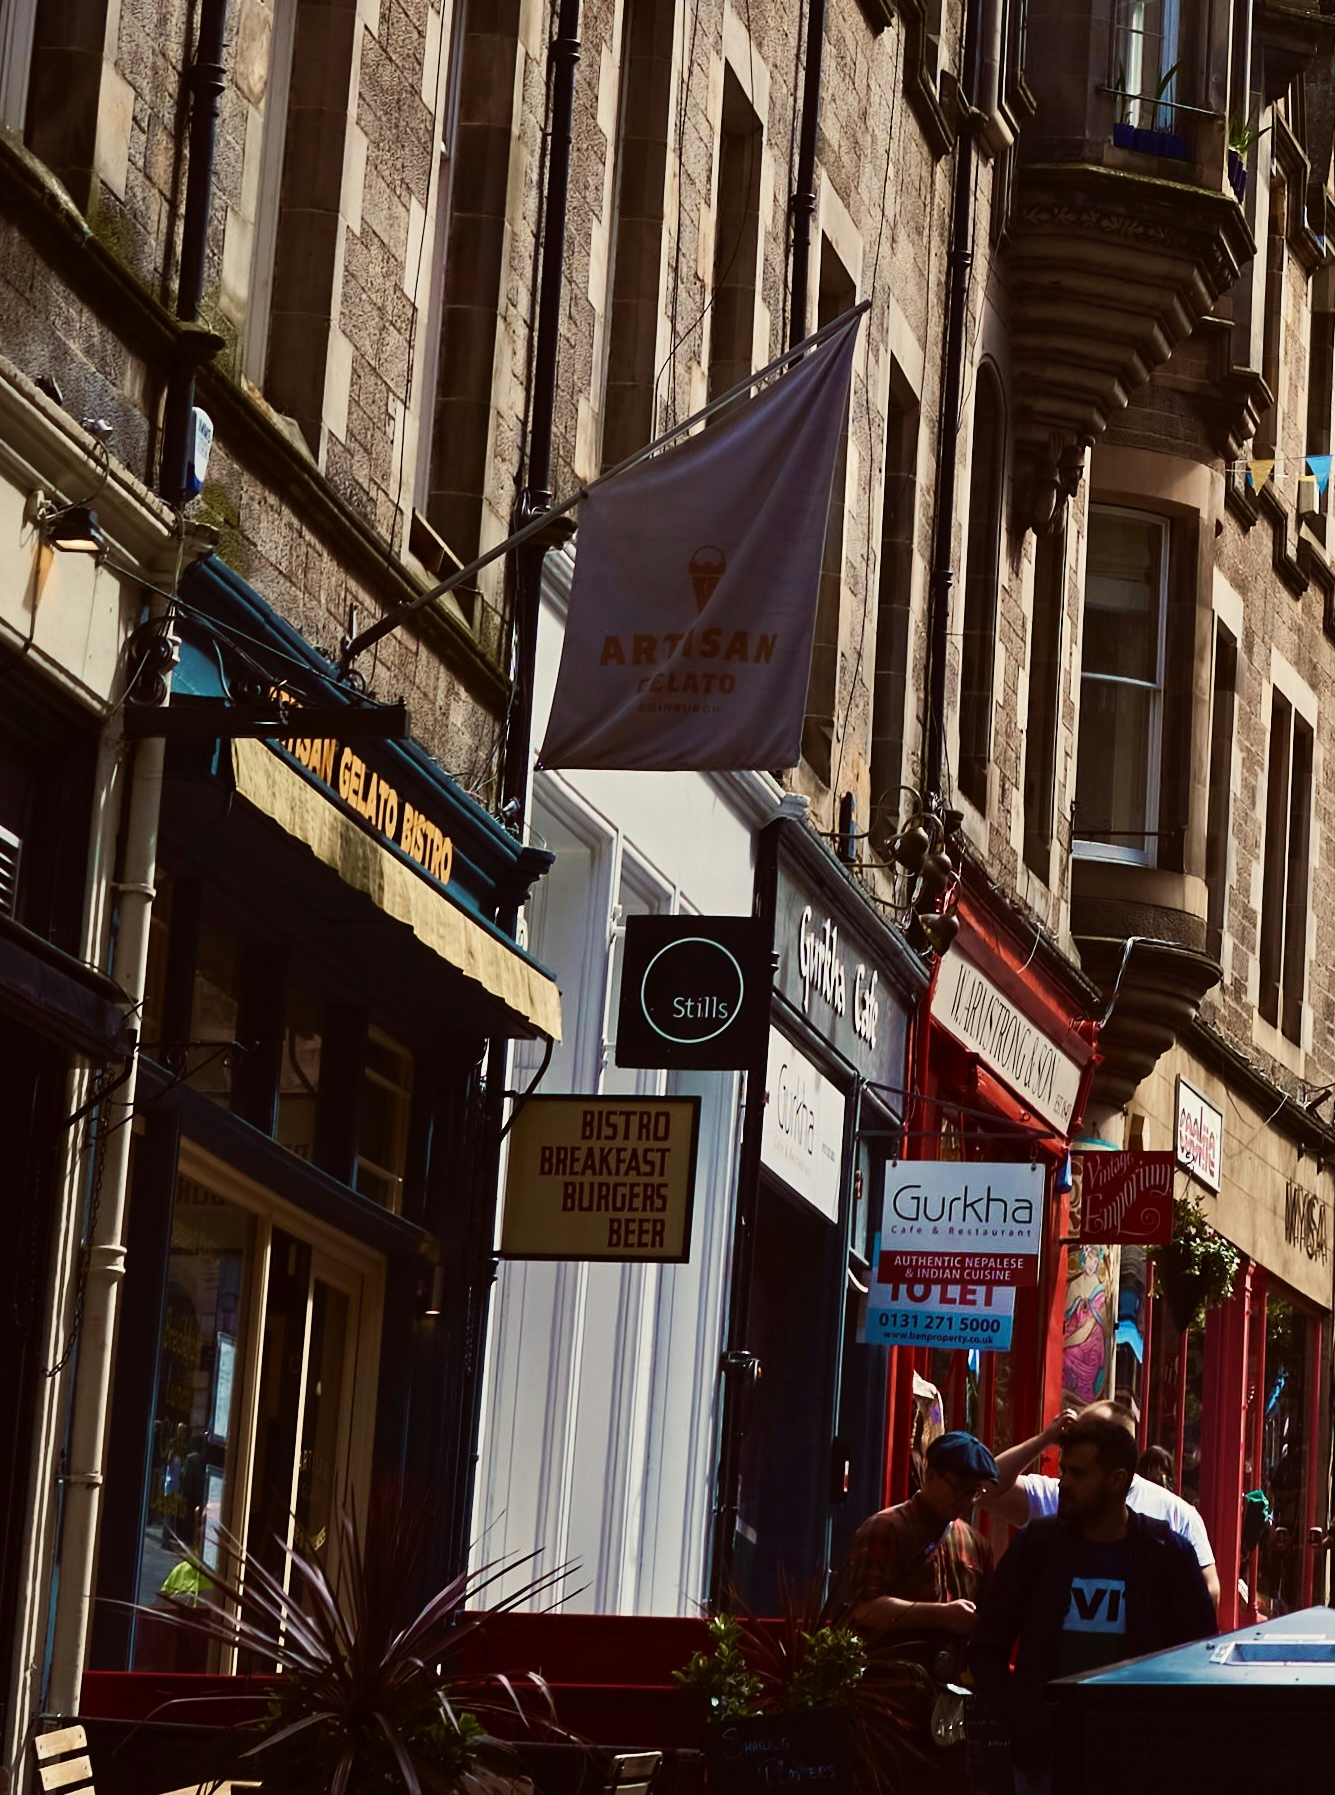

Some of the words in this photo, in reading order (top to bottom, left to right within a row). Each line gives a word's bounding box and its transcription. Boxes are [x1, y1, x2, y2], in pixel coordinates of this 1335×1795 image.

[599, 628, 778, 666] ARTISAN
[639, 702, 722, 714] EDINBURGH
[338, 747, 399, 840] GELATO
[400, 802, 454, 887] BISTRO
[801, 905, 846, 1017] Gurkha
[672, 996, 729, 1019] Stills
[959, 977, 1031, 1081] ARMSTRONG
[1031, 1043, 1061, 1104] SON
[580, 1109, 671, 1142] BISTRO
[777, 1063, 814, 1156] Gurkha
[539, 1145, 671, 1177] BREAKFAST
[1086, 1151, 1134, 1190] Vintage
[561, 1181, 669, 1213] BURGERS
[893, 1184, 1034, 1224] Gurkha
[1083, 1160, 1171, 1237] Emporium
[607, 1217, 666, 1249] BEER
[891, 1224, 923, 1235] Cafe
[932, 1226, 940, 1235] &
[948, 1226, 1032, 1238] Restaurant
[894, 1255, 961, 1268] AUTHENTIC
[964, 1256, 1024, 1269] NEPALESE
[905, 1268, 914, 1278] &
[917, 1268, 960, 1279] INDIAN
[964, 1269, 1012, 1281] CUISINE
[890, 1283, 933, 1303] TO
[939, 1284, 994, 1307] LET
[878, 1312, 919, 1329] 0131
[923, 1315, 952, 1330] 271
[959, 1316, 1001, 1333] 5000
[883, 1331, 994, 1345] www.benproperty.co.uk
